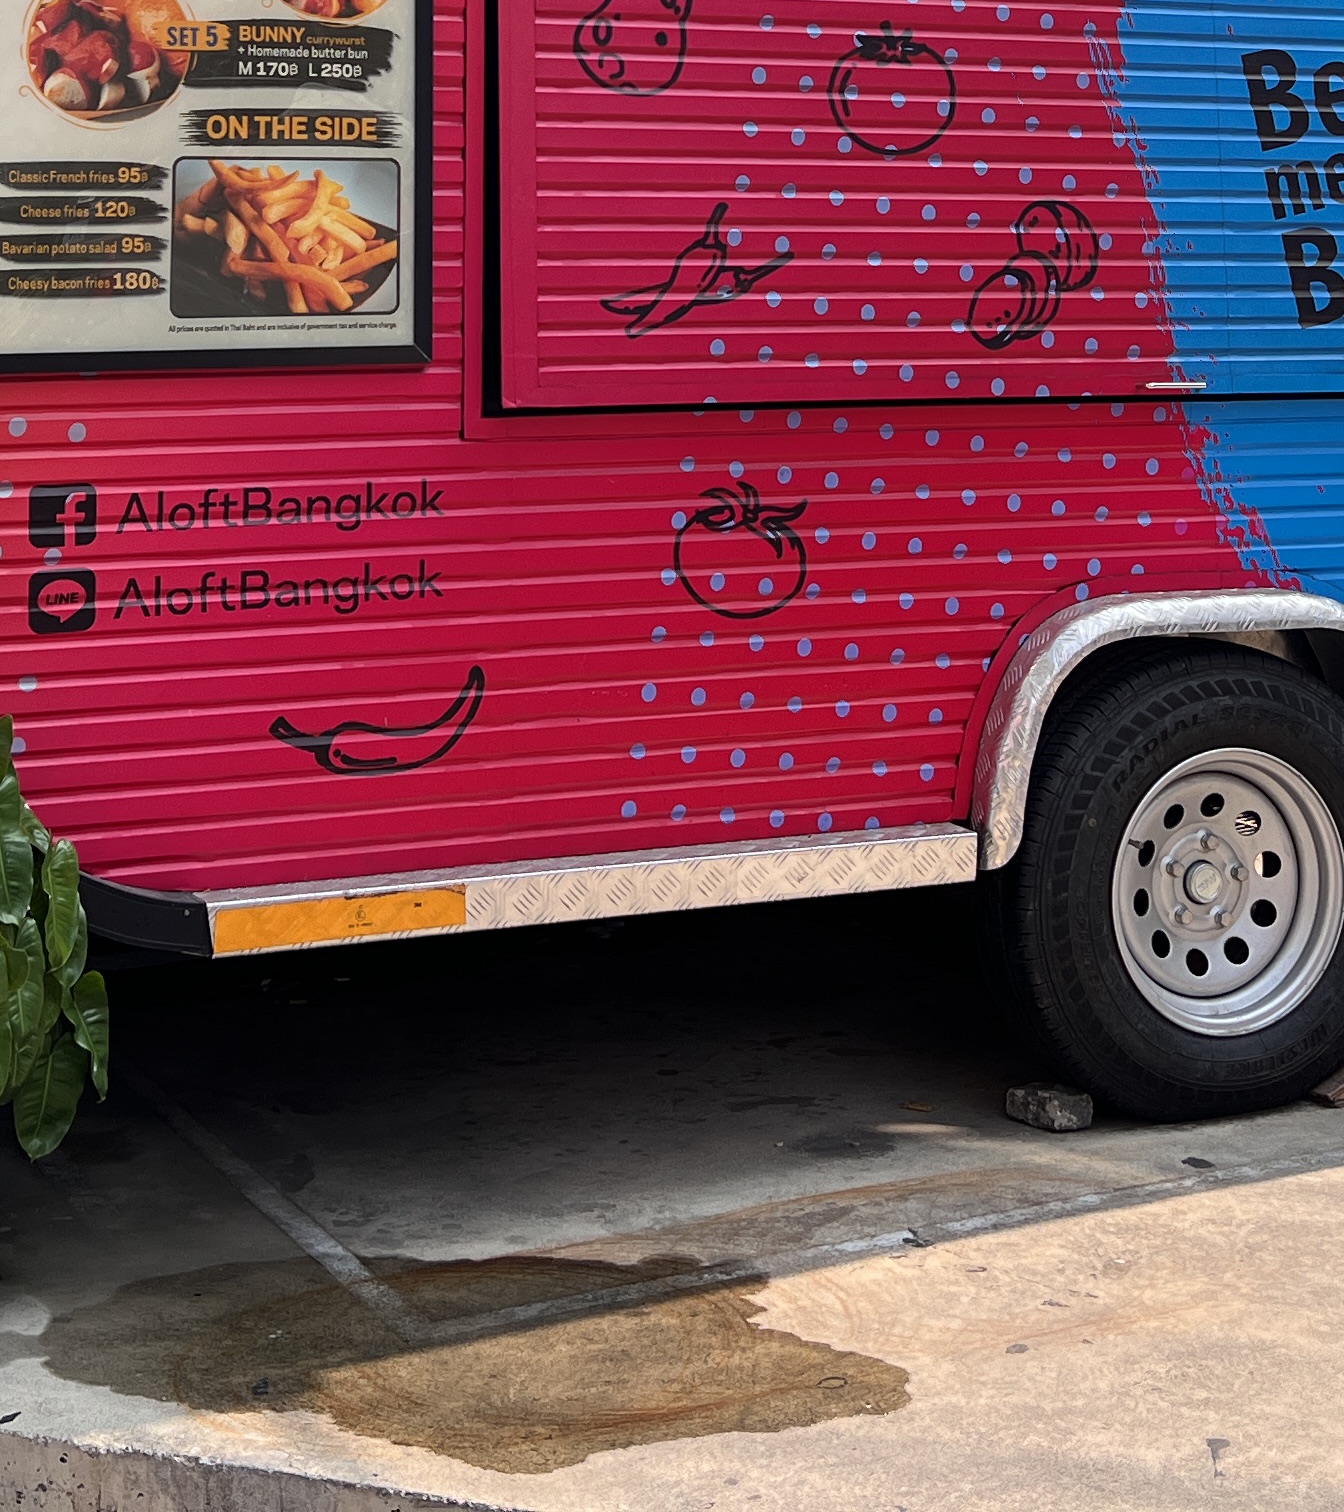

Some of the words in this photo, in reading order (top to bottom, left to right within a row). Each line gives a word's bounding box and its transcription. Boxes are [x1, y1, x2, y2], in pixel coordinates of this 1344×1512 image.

[166, 26, 200, 47] SET
[206, 25, 219, 47] 5
[239, 25, 305, 44] BUNNY
[306, 34, 366, 47] currywurst
[248, 44, 310, 58] Homemade
[311, 45, 346, 59] butter
[348, 47, 368, 59] bun
[238, 62, 252, 76] M
[309, 62, 318, 77] L
[207, 114, 250, 140] ON
[254, 115, 308, 140] THE
[314, 116, 378, 142] SIDE
[8, 170, 49, 183] Classic
[50, 171, 87, 183] French
[89, 171, 115, 183] fries
[20, 204, 61, 218] Cheese
[64, 205, 90, 218] fries
[2, 242, 50, 254] Bavarian
[51, 243, 86, 257] potato
[88, 241, 117, 254] salad
[8, 277, 50, 291] Cheesy
[51, 277, 83, 289] bacon
[85, 276, 110, 288] fries
[115, 478, 445, 534] AloftBangkok
[45, 592, 80, 606] LINE
[113, 559, 444, 619] AloftBangkok
